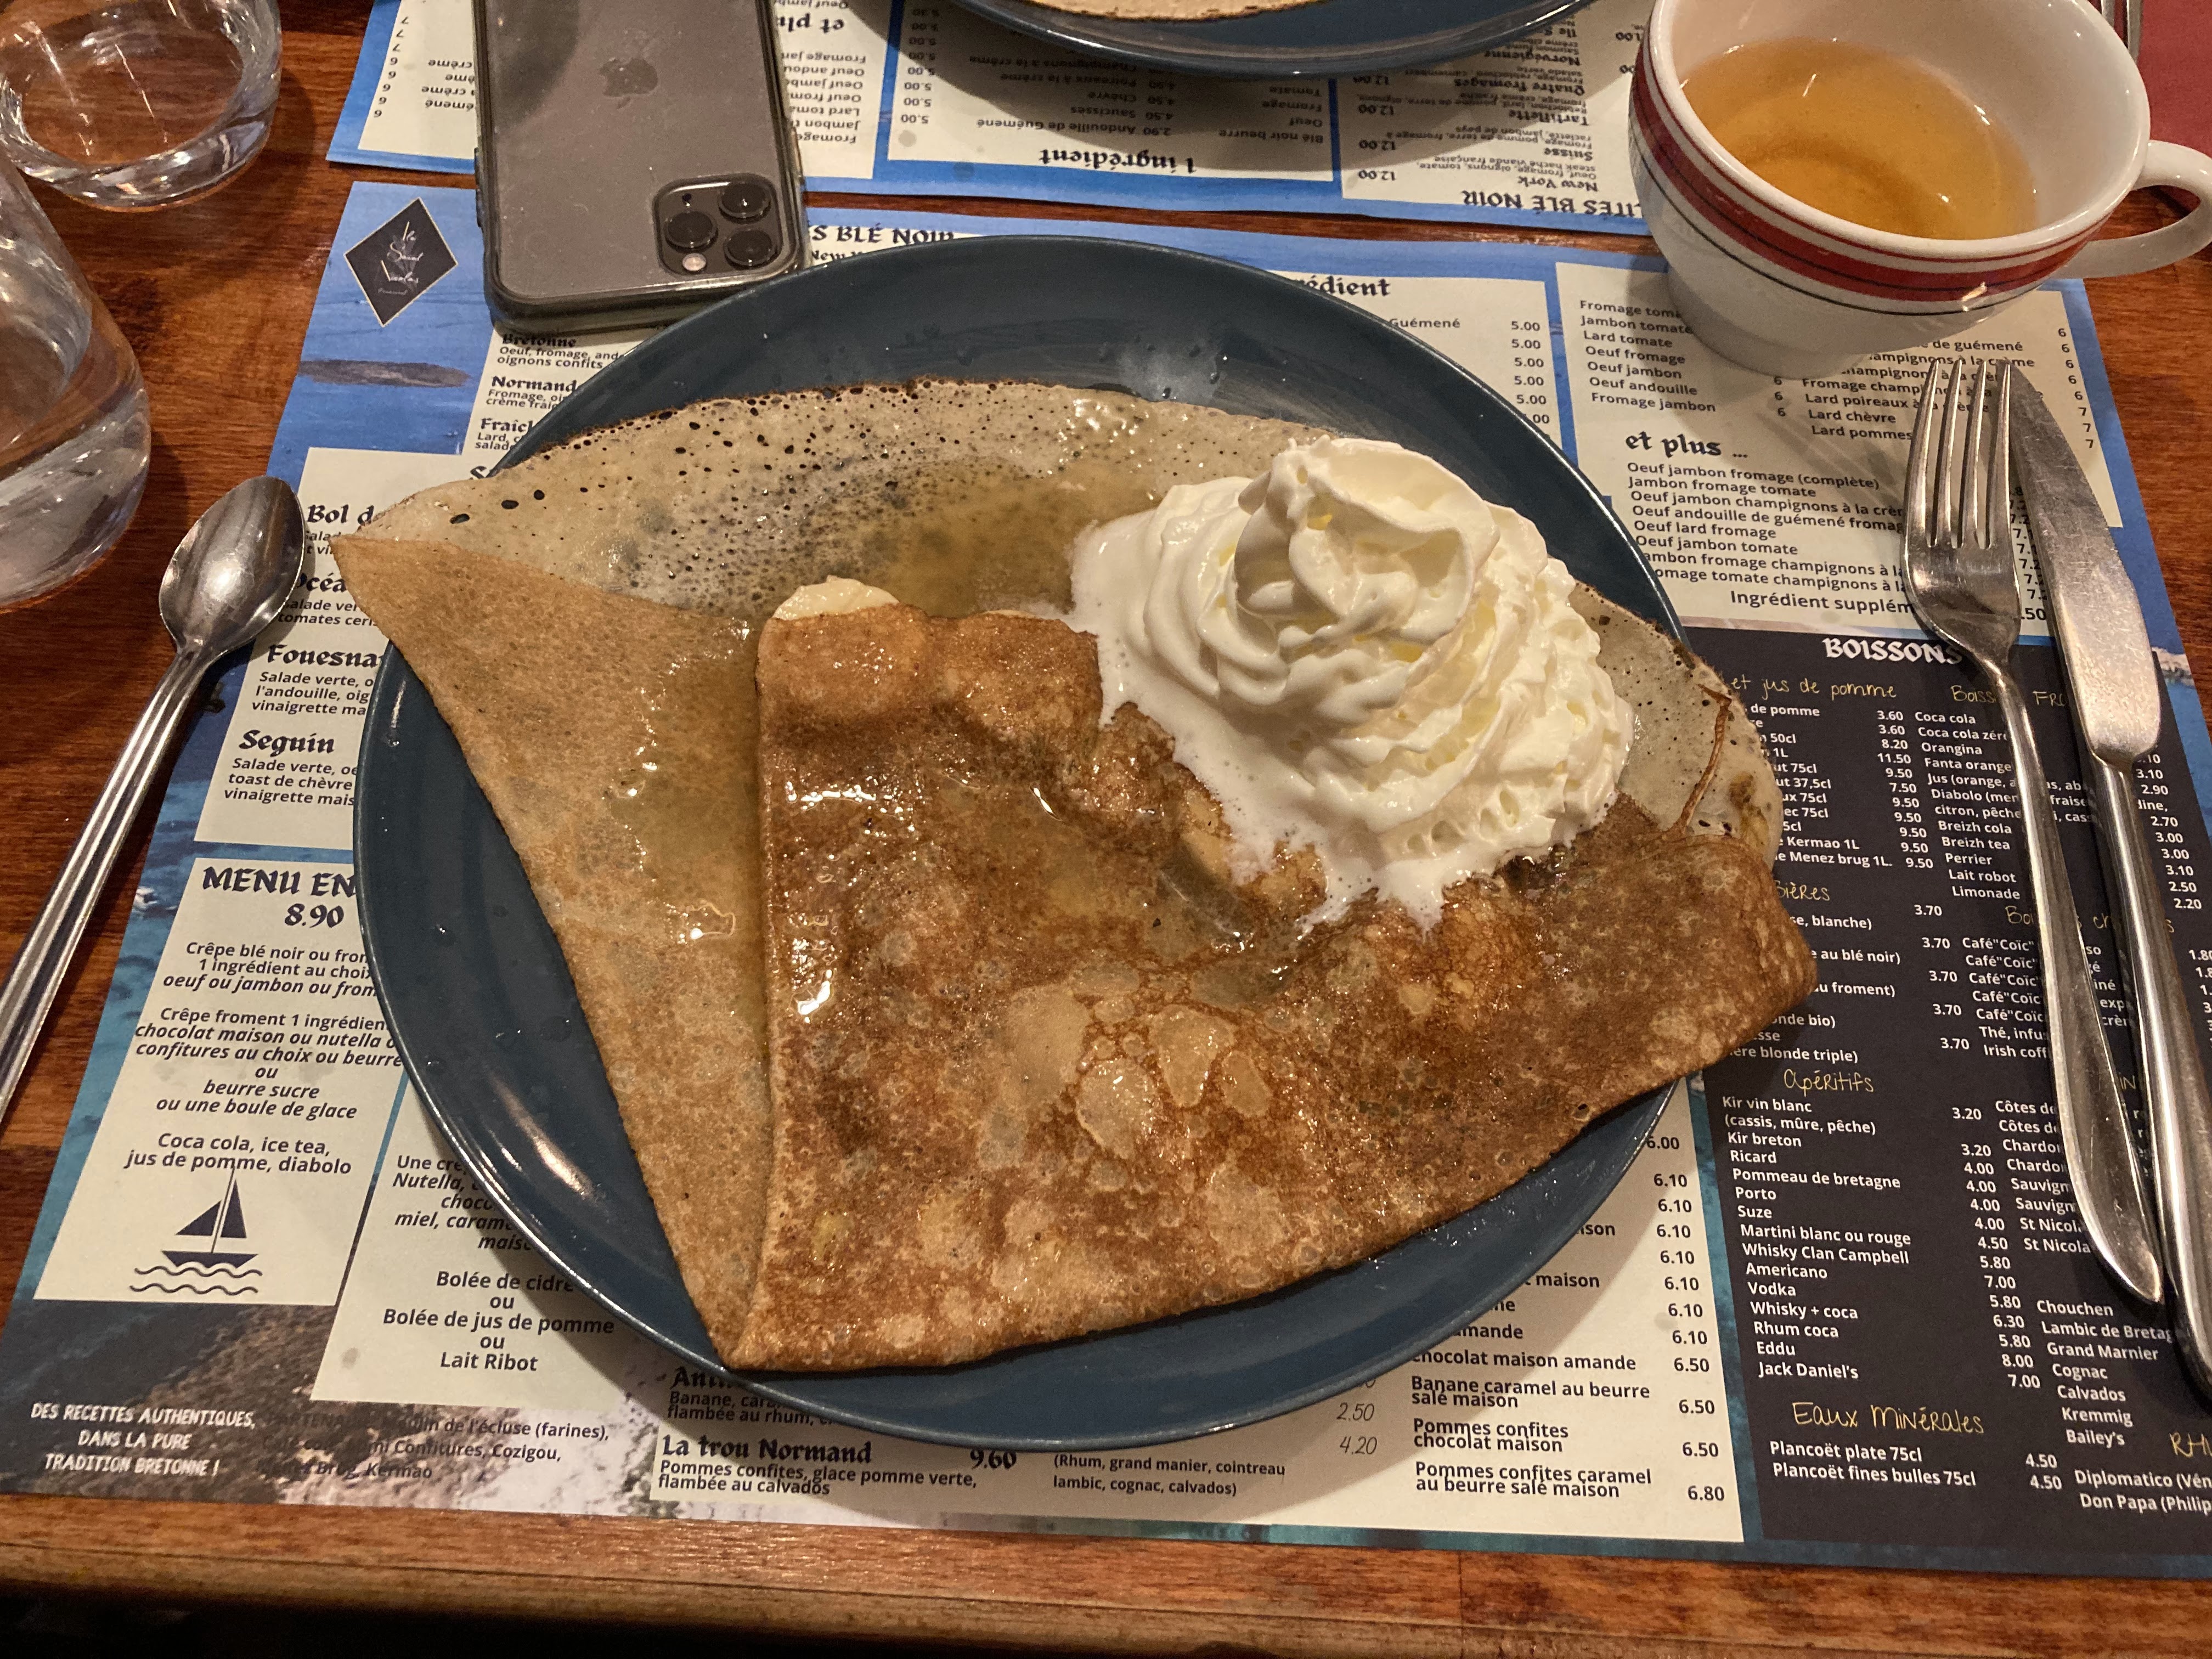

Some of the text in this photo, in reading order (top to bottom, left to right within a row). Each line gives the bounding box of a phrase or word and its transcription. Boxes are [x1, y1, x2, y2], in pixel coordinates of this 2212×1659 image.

[827, 94, 862, 103] Oeuf
[904, 98, 931, 107] 5.00
[828, 107, 860, 117] Lard
[901, 114, 928, 124] 5.00
[1040, 149, 1175, 173] ingrédient
[1544, 148, 1593, 161] Suisse
[1561, 180, 1598, 192] New
[1462, 190, 1575, 215] BLÉ NOIR
[837, 222, 883, 243] BLÉ
[1389, 318, 1460, 328] Guémené
[1511, 321, 1540, 331] 5.00
[1584, 330, 1672, 347] Lard tomate
[1954, 341, 2023, 352] guémené
[1585, 346, 1685, 366] Oeuf fromage
[2062, 344, 2069, 353] 6
[498, 354, 602, 369] oignons confits
[1515, 358, 1544, 368] 5.00
[1588, 362, 1681, 378] Oeuf jambon
[1626, 431, 1722, 458] et plus
[1628, 462, 1879, 490] Oeuf jambon fromage (complète)
[1634, 521, 1776, 540] Oeuf lard fromage
[1731, 591, 1829, 608] Ingrédient
[1822, 636, 1963, 664] BOISSONS
[256, 685, 340, 701] l'andouille,
[1731, 674, 1896, 700] et jus de pomme
[1877, 710, 1903, 720] 3.60
[239, 730, 334, 757] Seguin
[1882, 739, 1908, 749] 8.20
[1922, 742, 1982, 756] Orangina
[233, 758, 335, 775] Salade verte,
[229, 774, 352, 790] toast de chèvre
[1787, 837, 1859, 849] Kermao 1L
[2155, 832, 2183, 843] 3.00
[1945, 853, 1992, 865] Perrier
[202, 867, 358, 896] MENU EN
[1949, 870, 2016, 882] Lait robot
[1952, 886, 2020, 899] Limonade
[1914, 905, 1942, 916] 3.70
[2174, 898, 2202, 909] 2.20
[285, 903, 344, 928] 8.90
[187, 942, 329, 961] Crêpe blé noir ou
[135, 1023, 381, 1048] chocolat maison ou nutella
[203, 1079, 319, 1098] beurre sucre
[156, 1098, 357, 1121] ou une boule de glace
[1723, 1097, 1812, 1112] Kir vin blanc
[159, 1133, 329, 1156] Coca cola, ice tea,
[123, 1150, 351, 1174] jus de pomme, diabolo
[1730, 1150, 1776, 1163] Ricard
[1736, 1187, 1776, 1200] Porto
[1738, 1205, 1771, 1218] Suze
[1661, 1250, 1694, 1264] 6.10
[1742, 1243, 1909, 1266] Whisky Clan Campbell
[1747, 1282, 1796, 1296] Vodka
[2037, 1300, 2113, 1316] Chouchen
[383, 1308, 614, 1335] Bolée de jus de pomme
[480, 1336, 505, 1349] ou
[1757, 1341, 1795, 1355] Eddu
[2047, 1342, 2158, 1359] Grand Marnier
[441, 1352, 538, 1371] Lait Ribot
[2002, 1354, 2033, 1368] 8.00
[1759, 1362, 1858, 1379] Jack Daniel's
[2052, 1363, 2108, 1381] Cognac
[1412, 1376, 1649, 1398] Banane caramel au beurre
[2008, 1374, 2040, 1388] 7.00
[1412, 1392, 1517, 1408] salé maison
[2057, 1385, 2125, 1401] Calvados
[1336, 1402, 1374, 1421] 2.50
[1679, 1400, 1714, 1414] 6.50
[1792, 1402, 1858, 1427] Eaux
[31, 1403, 255, 1429] DES RECETTES AUTHENTIQUES,
[1414, 1418, 1568, 1438] Pommes confites
[78, 1430, 192, 1450] DANS LA PURE
[1340, 1436, 1377, 1455] 4.20
[1414, 1431, 1562, 1452] chocolat maison
[2066, 1430, 2125, 1448] Bailey's
[663, 1434, 871, 1464] La trou Normand
[1683, 1442, 1718, 1457] 6.50
[46, 1453, 132, 1472] TRADITION
[134, 1457, 210, 1476] BRETONNE
[969, 1449, 1017, 1469] 9.60
[1773, 1462, 1976, 1486] Plancoët fines bulles 75cl
[2030, 1475, 2062, 1489] 4.50
[659, 1474, 830, 1496] flambée au calvados
[1054, 1475, 1236, 1497] lambic, cognac, calvados)
